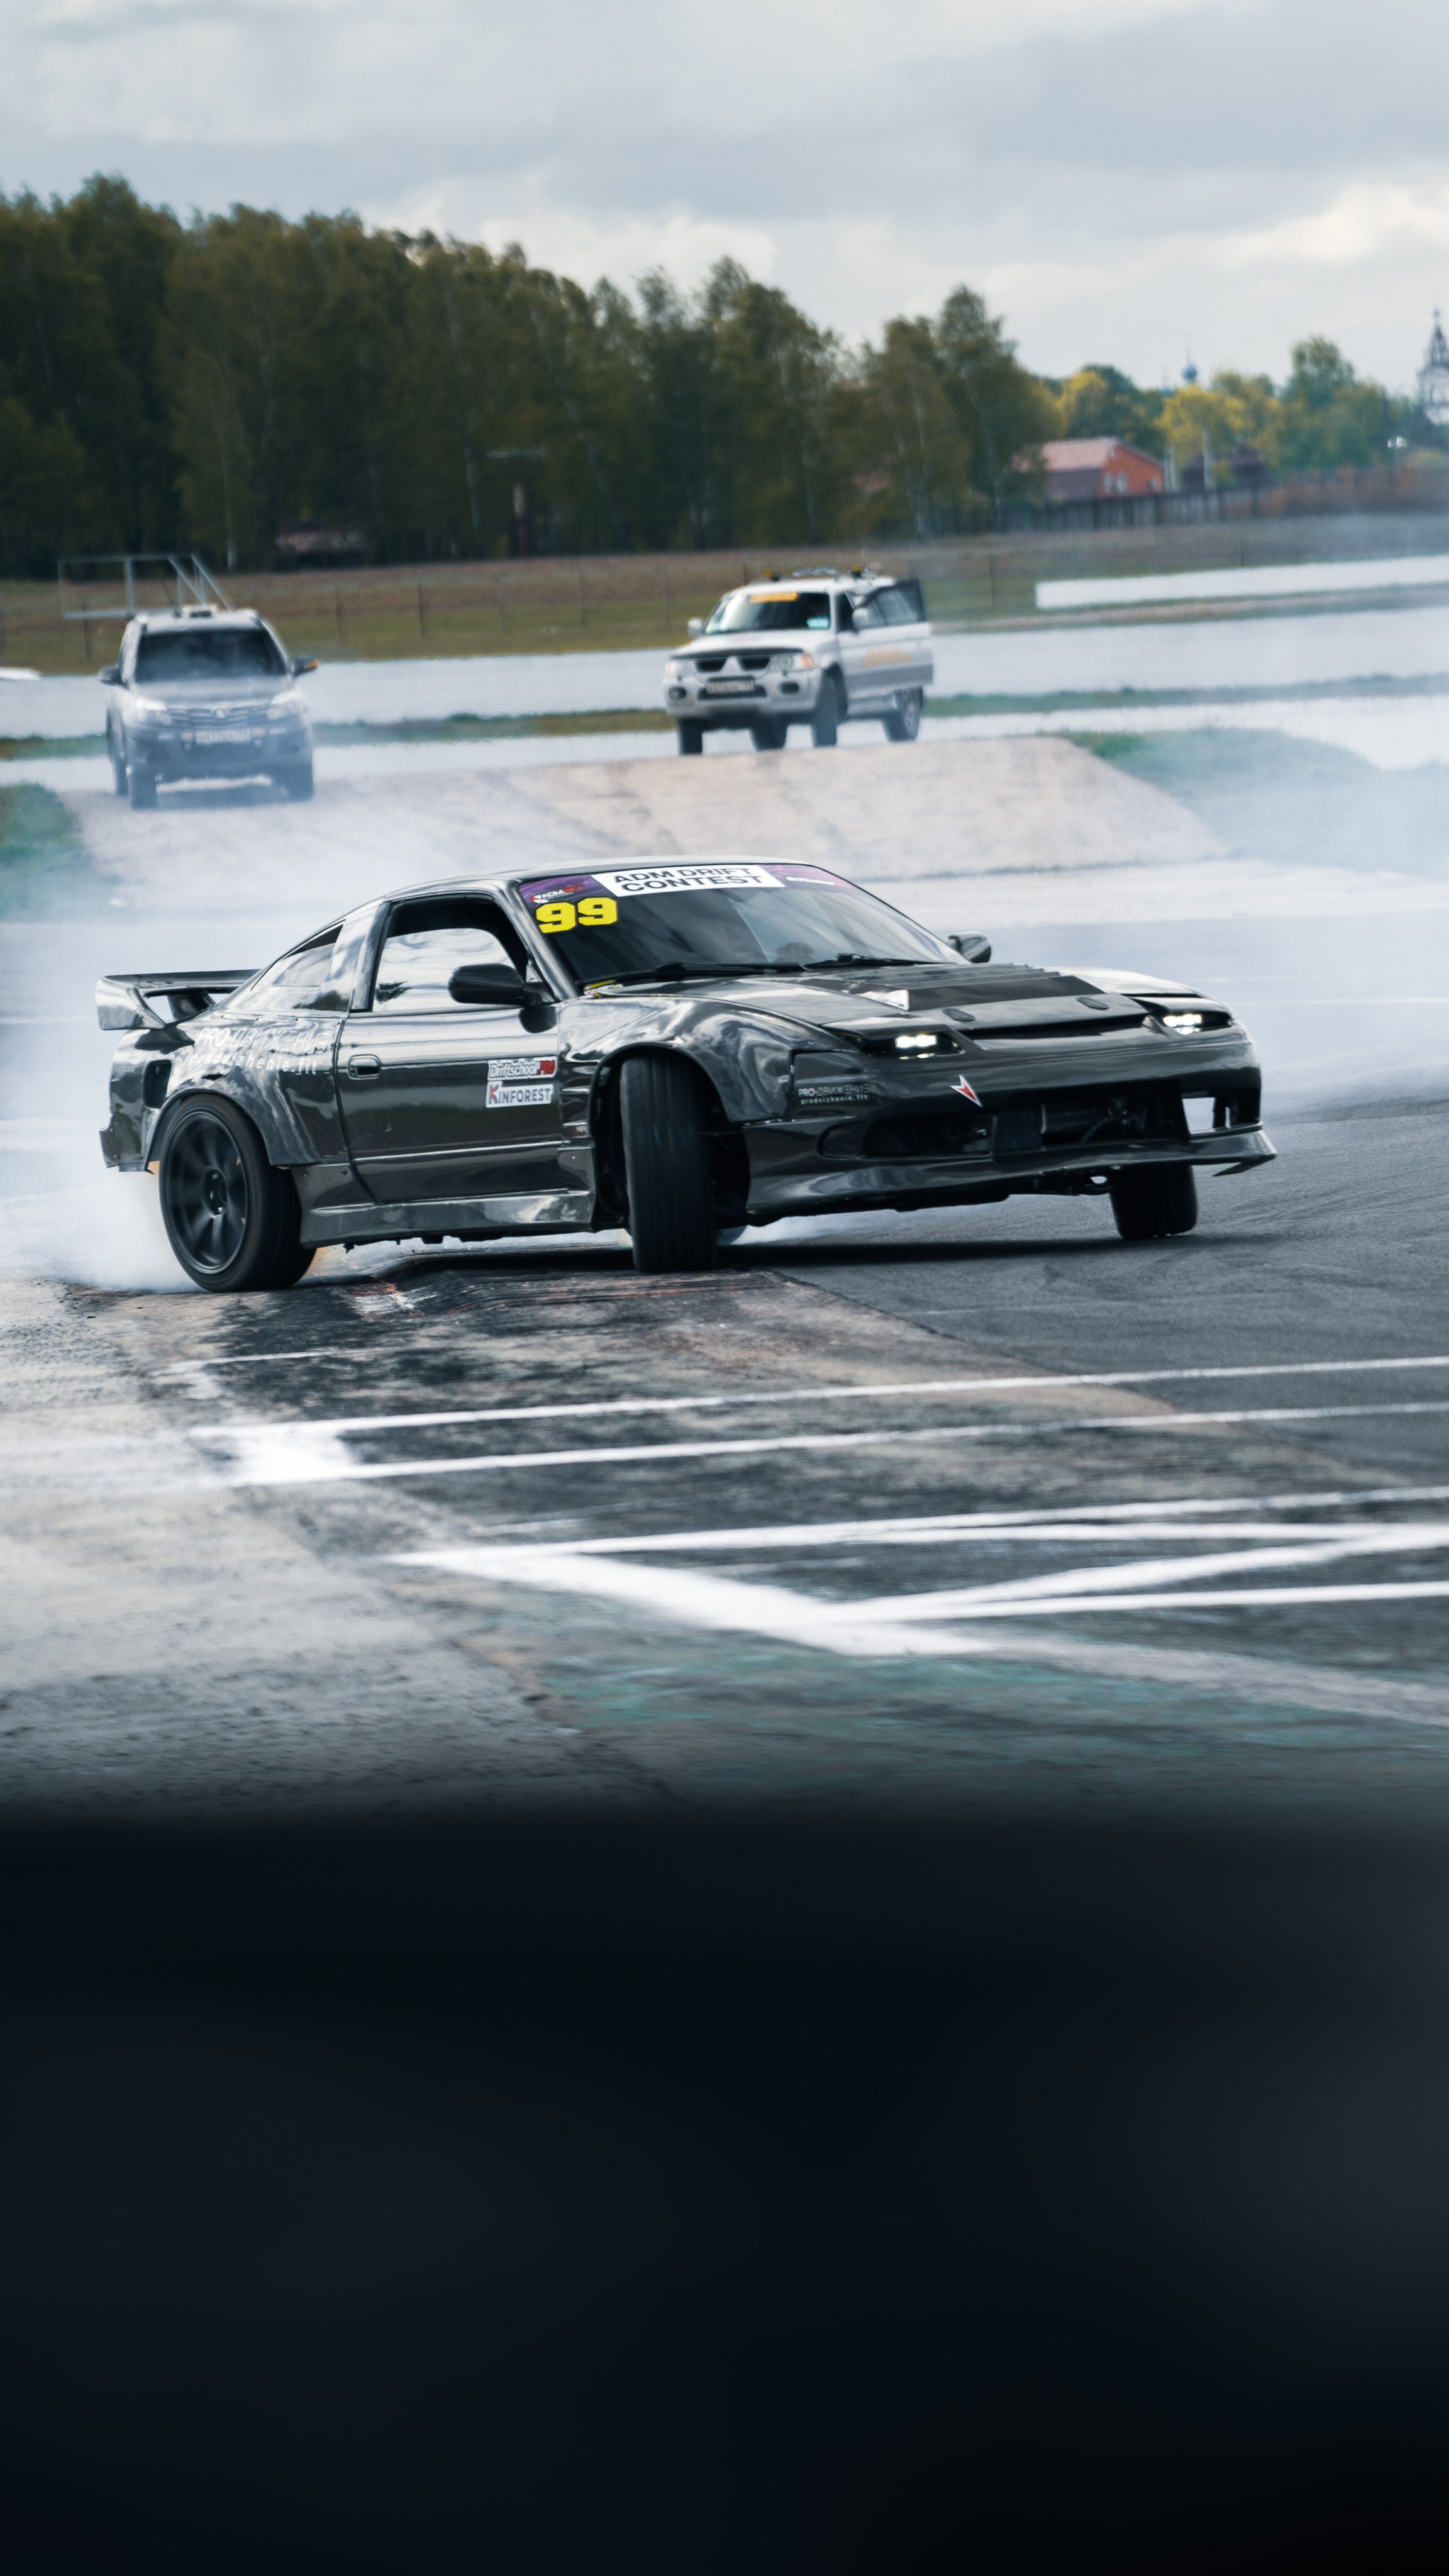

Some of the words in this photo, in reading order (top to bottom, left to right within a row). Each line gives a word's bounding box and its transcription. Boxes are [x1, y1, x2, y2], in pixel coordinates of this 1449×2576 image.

[615, 871, 674, 883] ADM
[677, 868, 752, 877] DRIFT
[622, 876, 762, 891] CONTEST
[536, 897, 618, 933] 99
